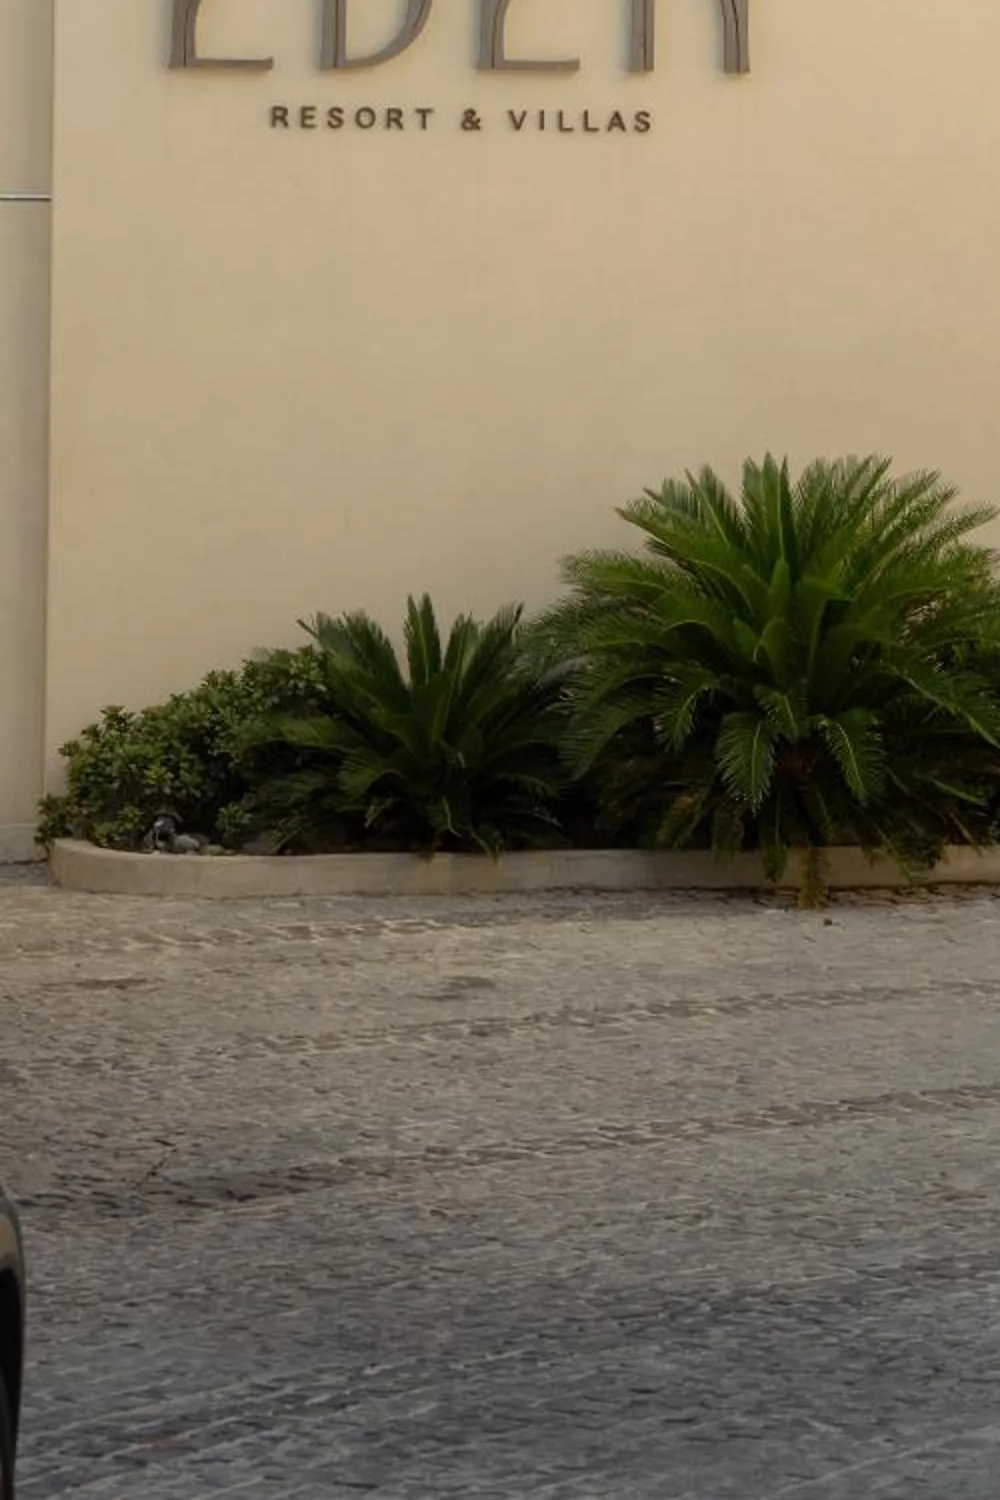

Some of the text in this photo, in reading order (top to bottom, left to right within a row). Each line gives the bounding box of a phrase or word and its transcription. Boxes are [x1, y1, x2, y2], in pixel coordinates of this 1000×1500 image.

[269, 104, 653, 134] RESORT & VILLAS
